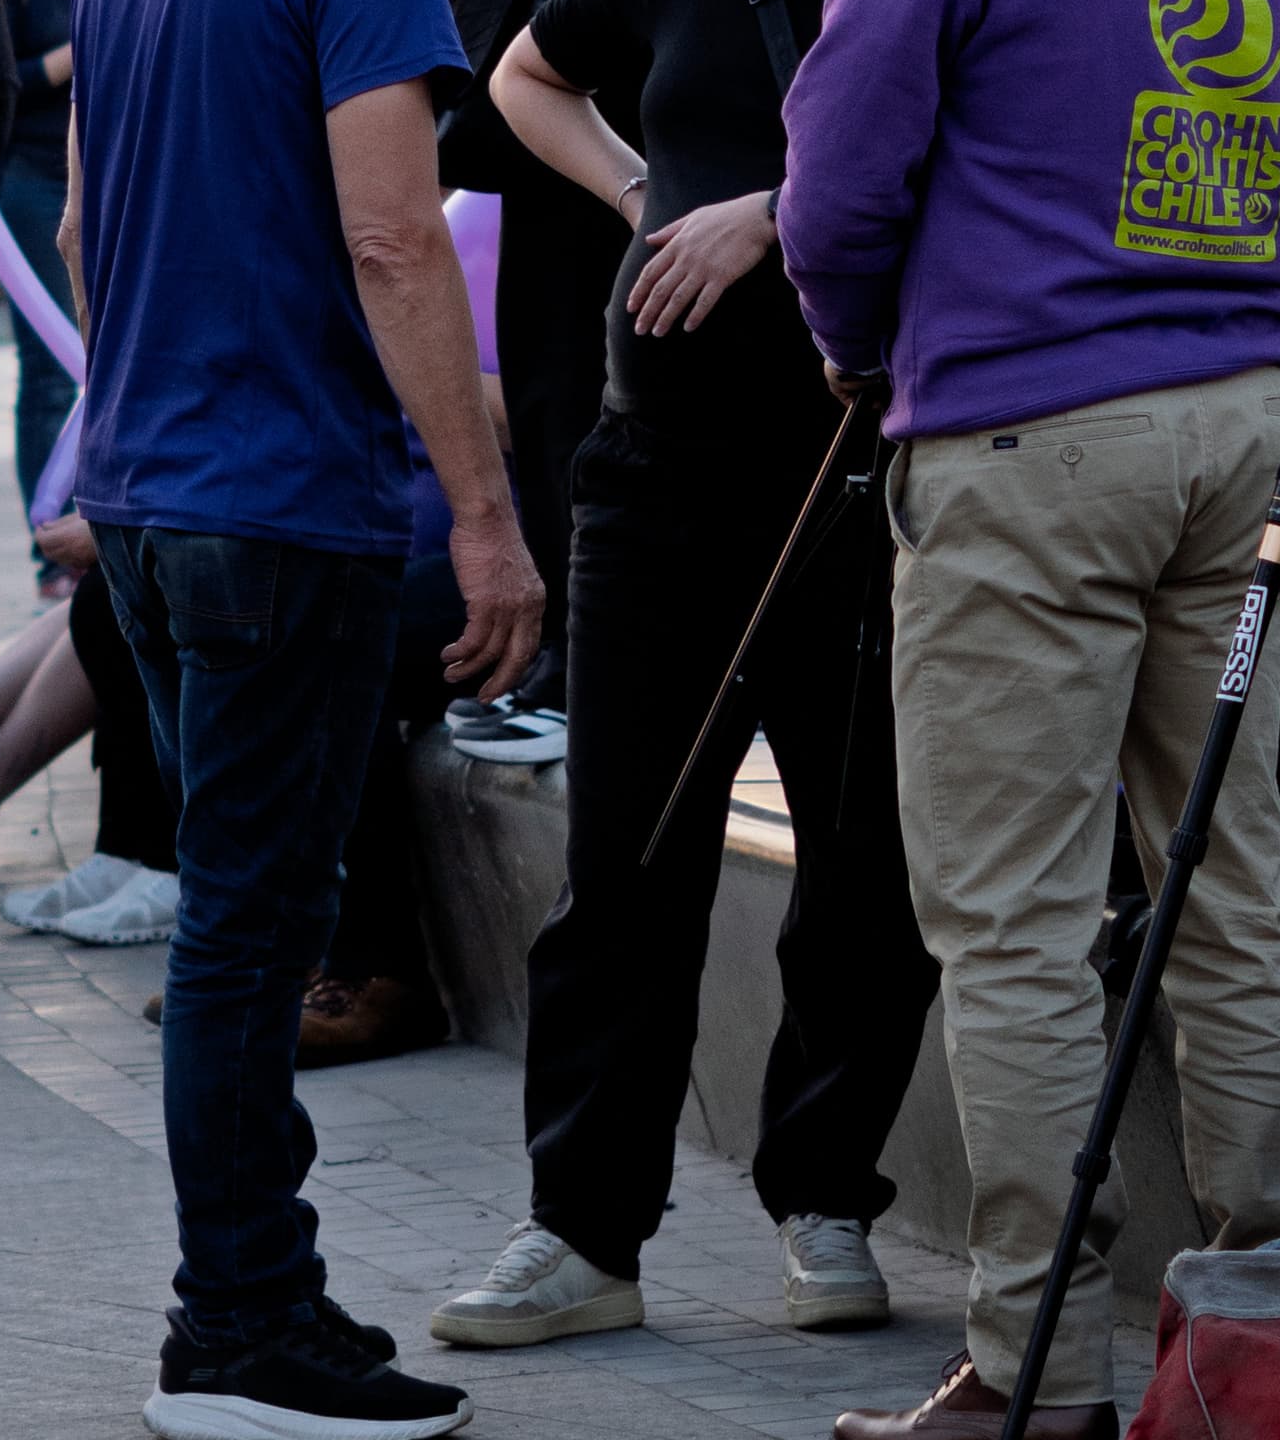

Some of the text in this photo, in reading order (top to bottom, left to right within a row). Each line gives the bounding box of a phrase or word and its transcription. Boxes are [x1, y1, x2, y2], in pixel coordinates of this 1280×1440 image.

[1130, 178, 1242, 226] CHILE
[1127, 230, 1266, 257] www.crohncolitis.cl
[1220, 592, 1261, 694] PRESS
